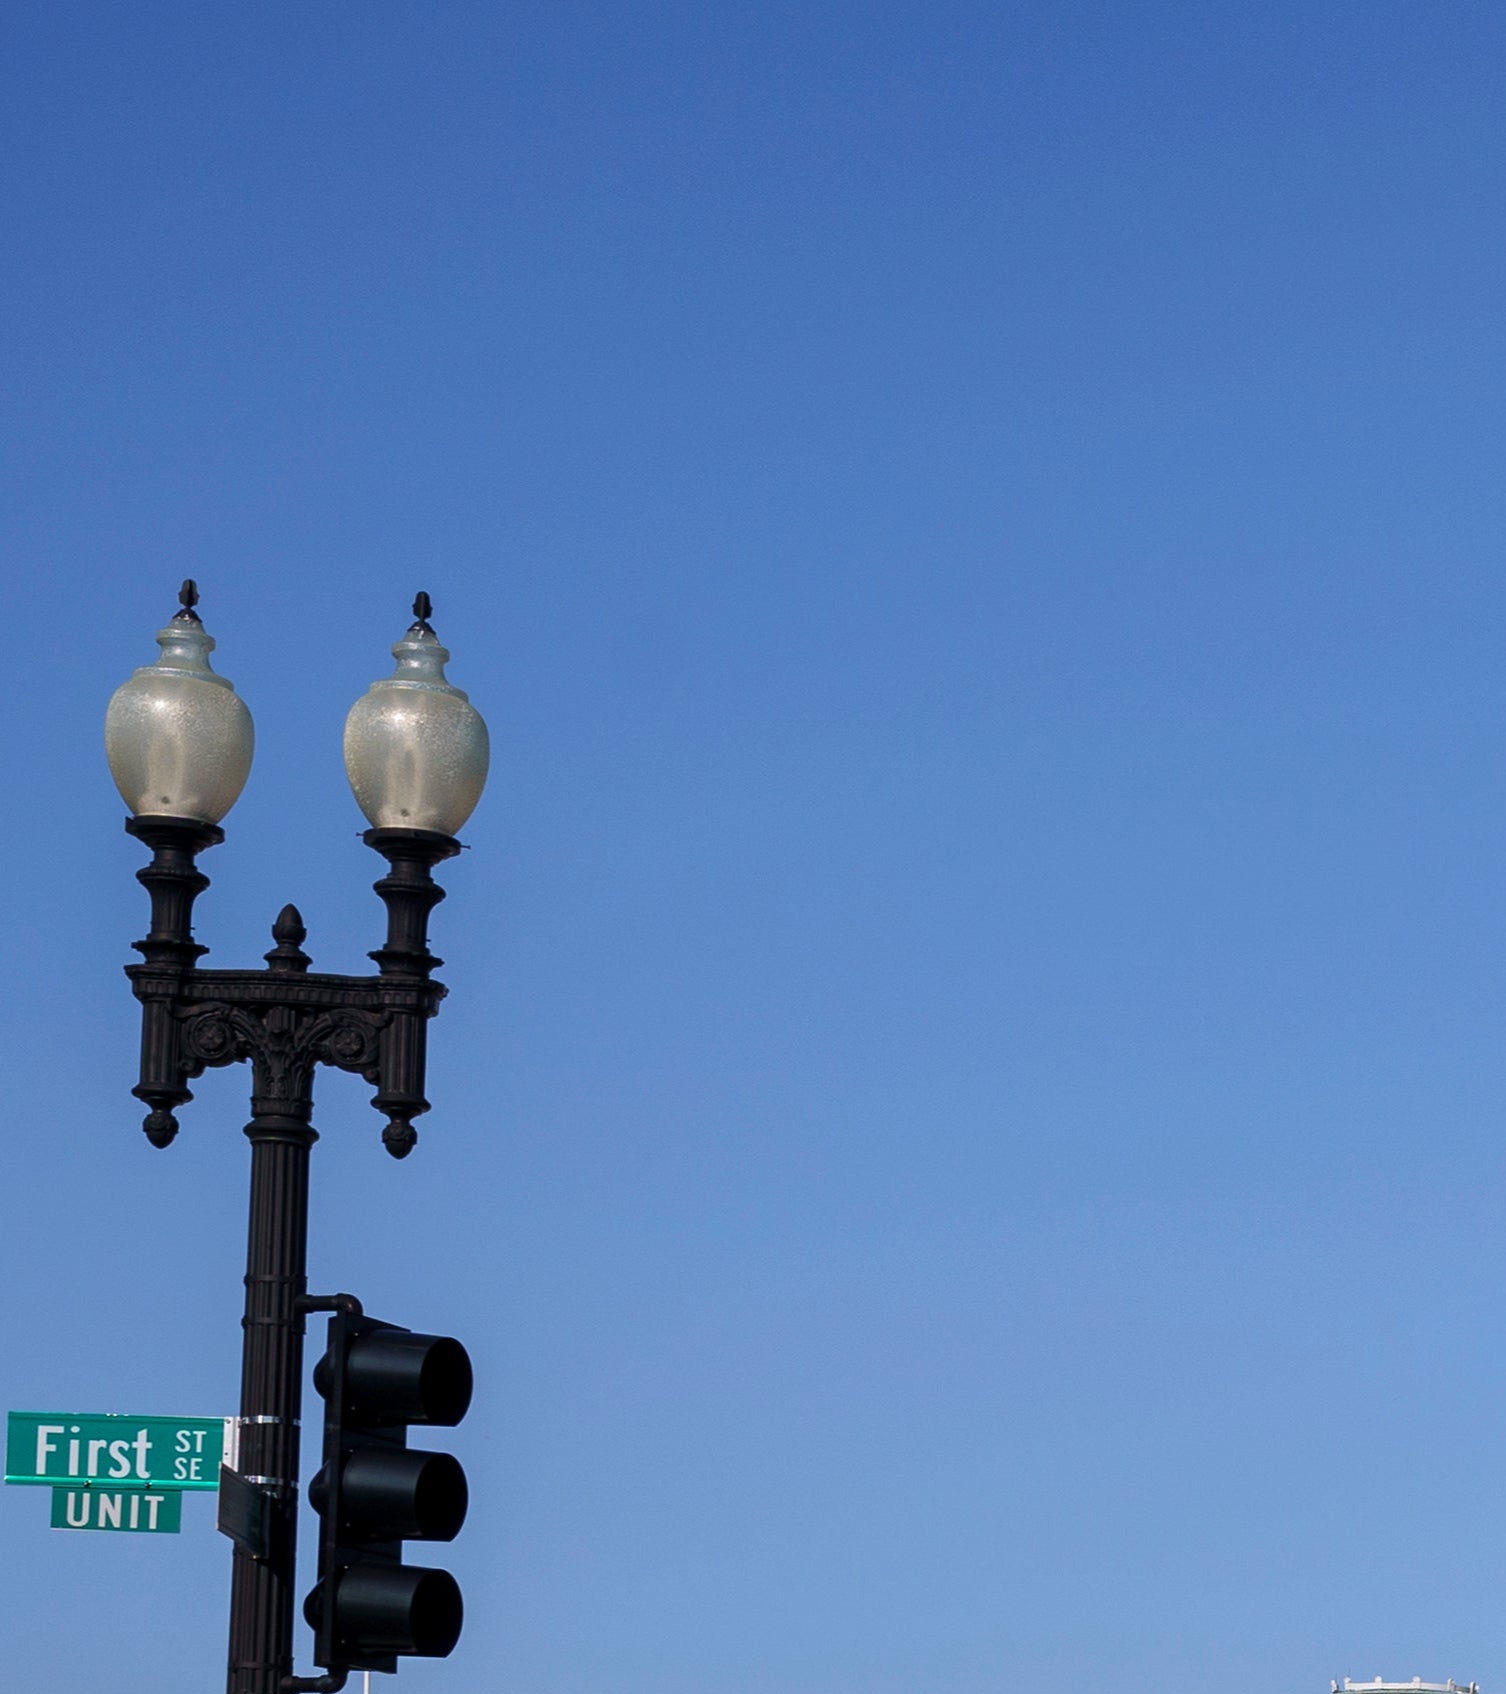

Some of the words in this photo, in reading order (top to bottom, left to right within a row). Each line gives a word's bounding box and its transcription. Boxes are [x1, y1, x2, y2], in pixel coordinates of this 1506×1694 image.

[36, 1425, 152, 1479] First
[174, 1430, 207, 1453] ST
[173, 1457, 203, 1480] SE
[66, 1492, 165, 1530] UNIT
